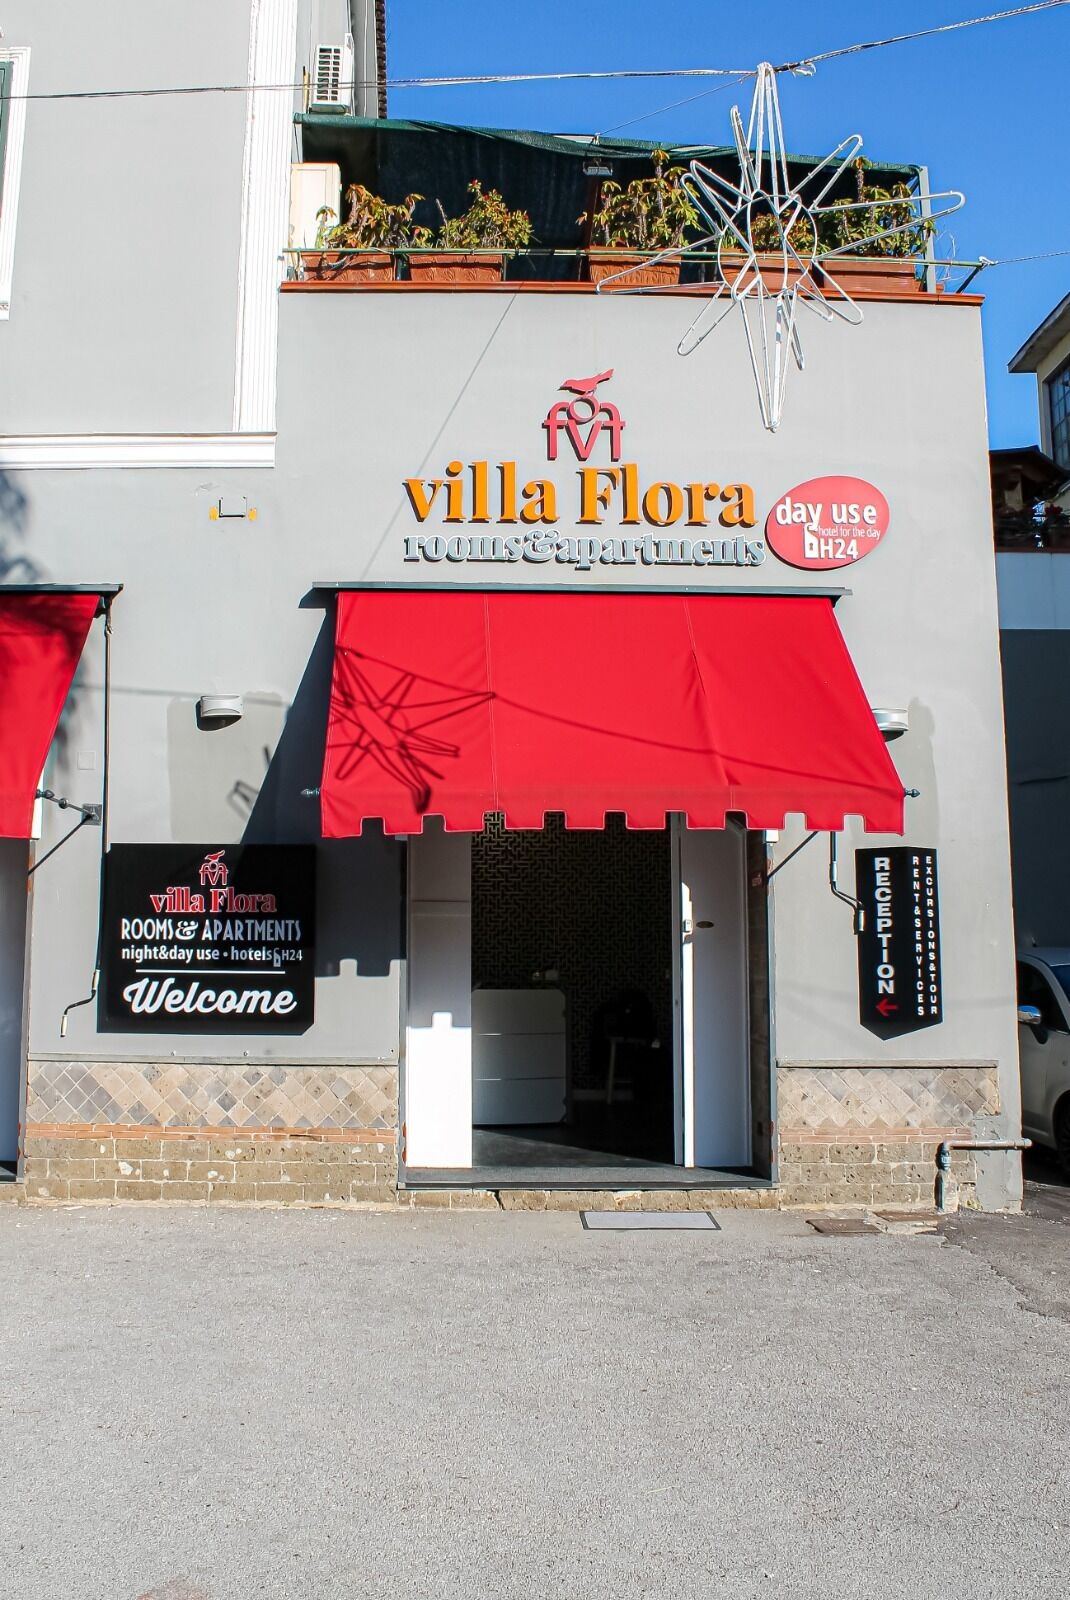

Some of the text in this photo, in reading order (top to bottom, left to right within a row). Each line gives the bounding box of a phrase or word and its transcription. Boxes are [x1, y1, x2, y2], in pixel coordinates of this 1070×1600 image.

[404, 461, 757, 525] villa Flora
[776, 497, 877, 531] day use
[818, 526, 881, 540] hotel for the day
[150, 887, 277, 913] villa Flora
[201, 919, 302, 941] APARTMENTS
[874, 857, 895, 994] RECEPTION
[121, 944, 193, 963] night&day
[196, 949, 219, 961] use
[123, 978, 297, 1014] Welcome
